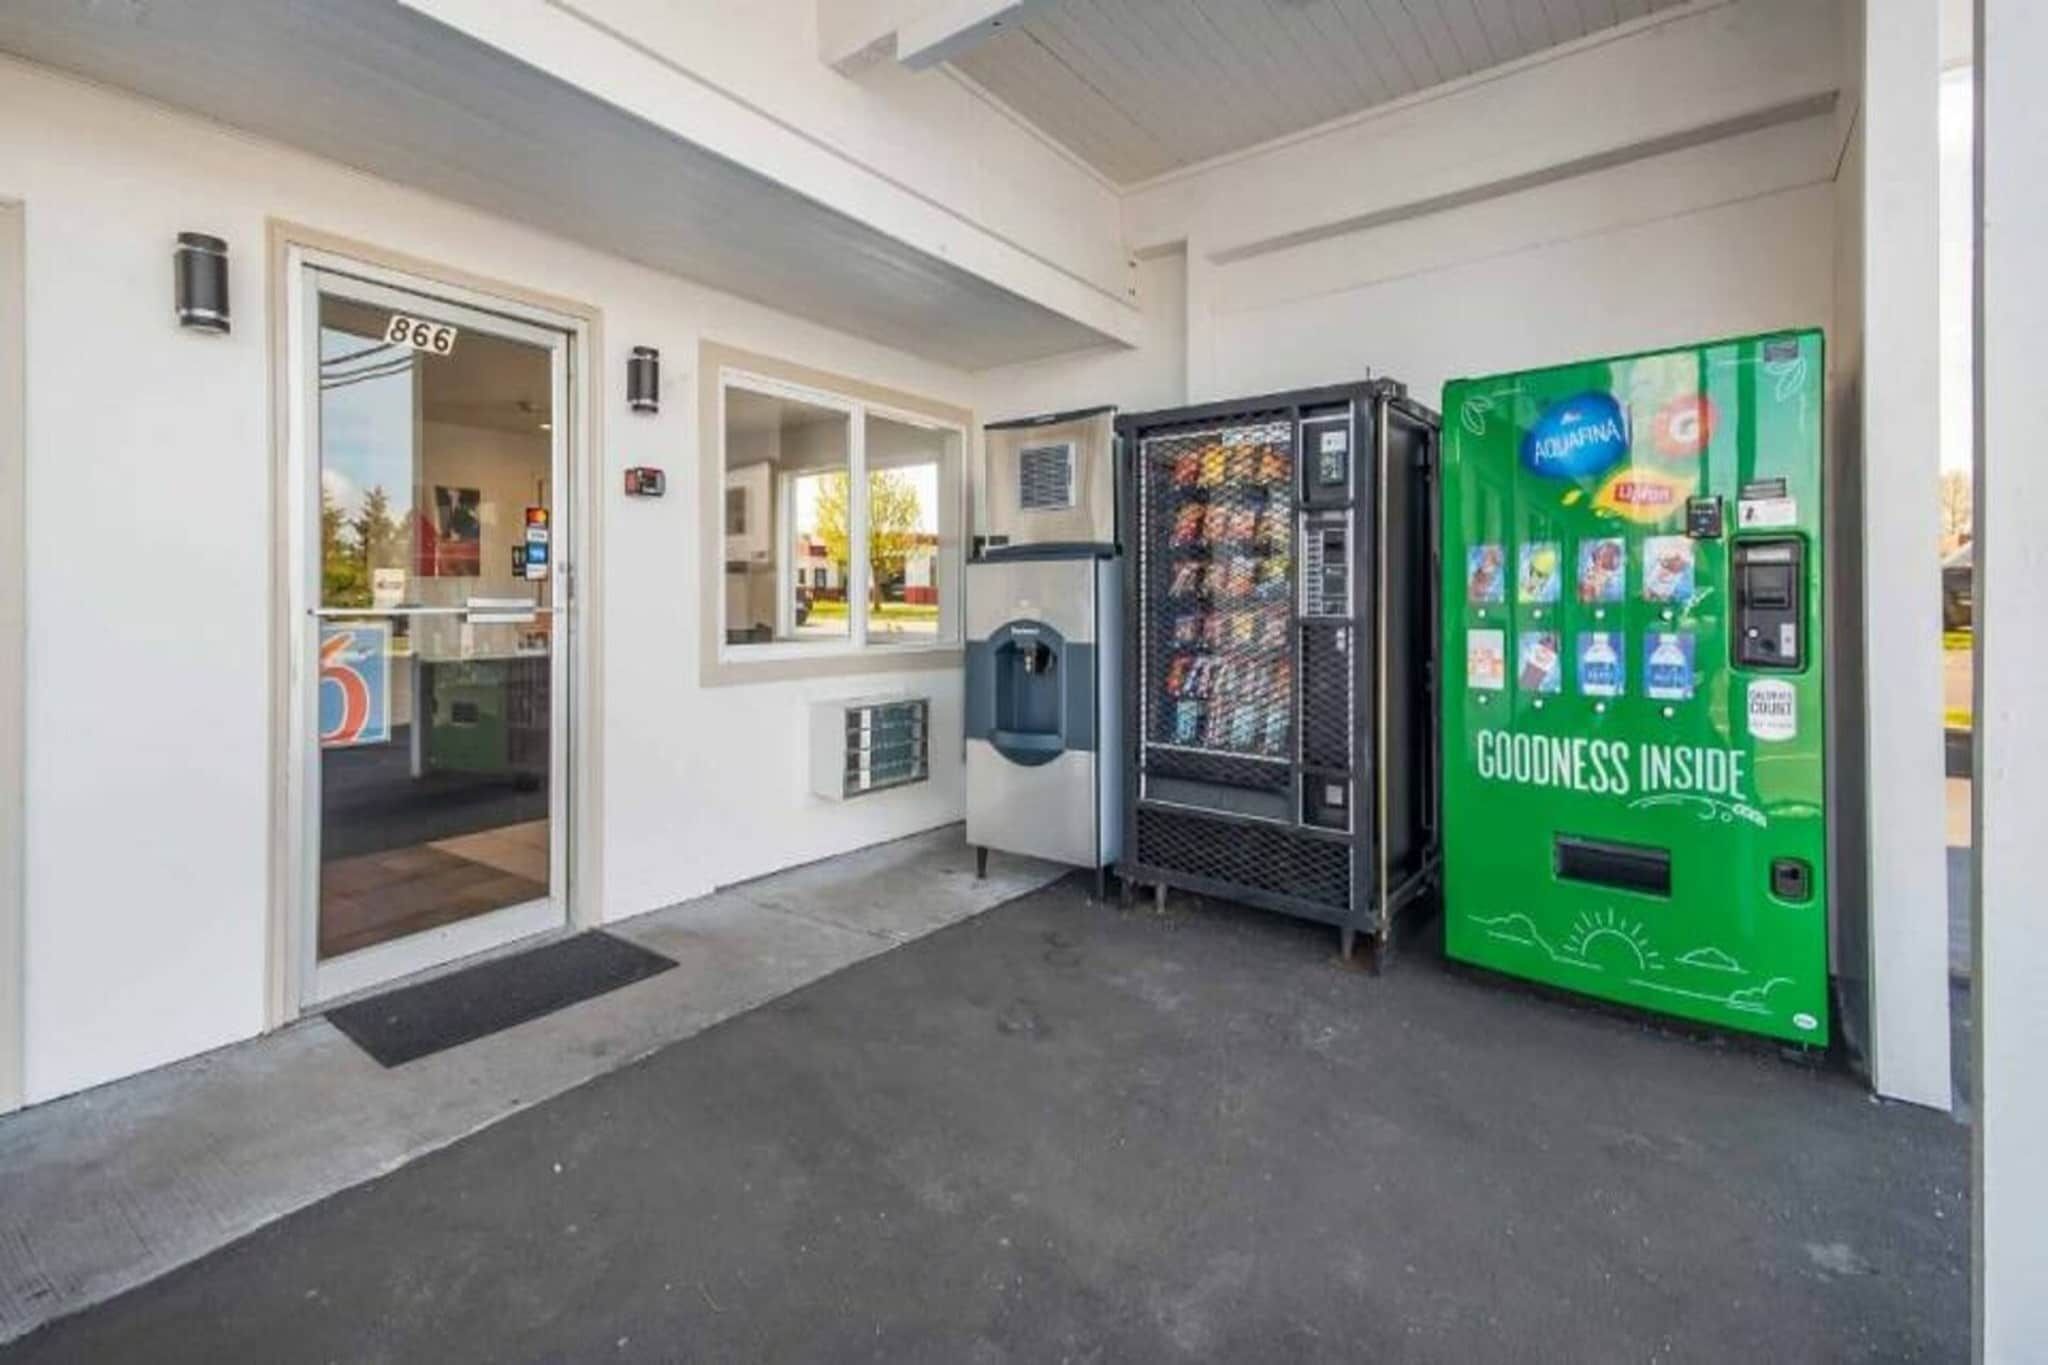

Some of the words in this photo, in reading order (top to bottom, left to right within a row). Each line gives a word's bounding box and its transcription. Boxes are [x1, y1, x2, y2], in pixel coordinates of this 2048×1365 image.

[389, 318, 451, 352] 866
[1535, 418, 1621, 466] AQUAFINA
[1477, 729, 1630, 795] GOODNESS
[1640, 744, 1746, 800] INSIDE
